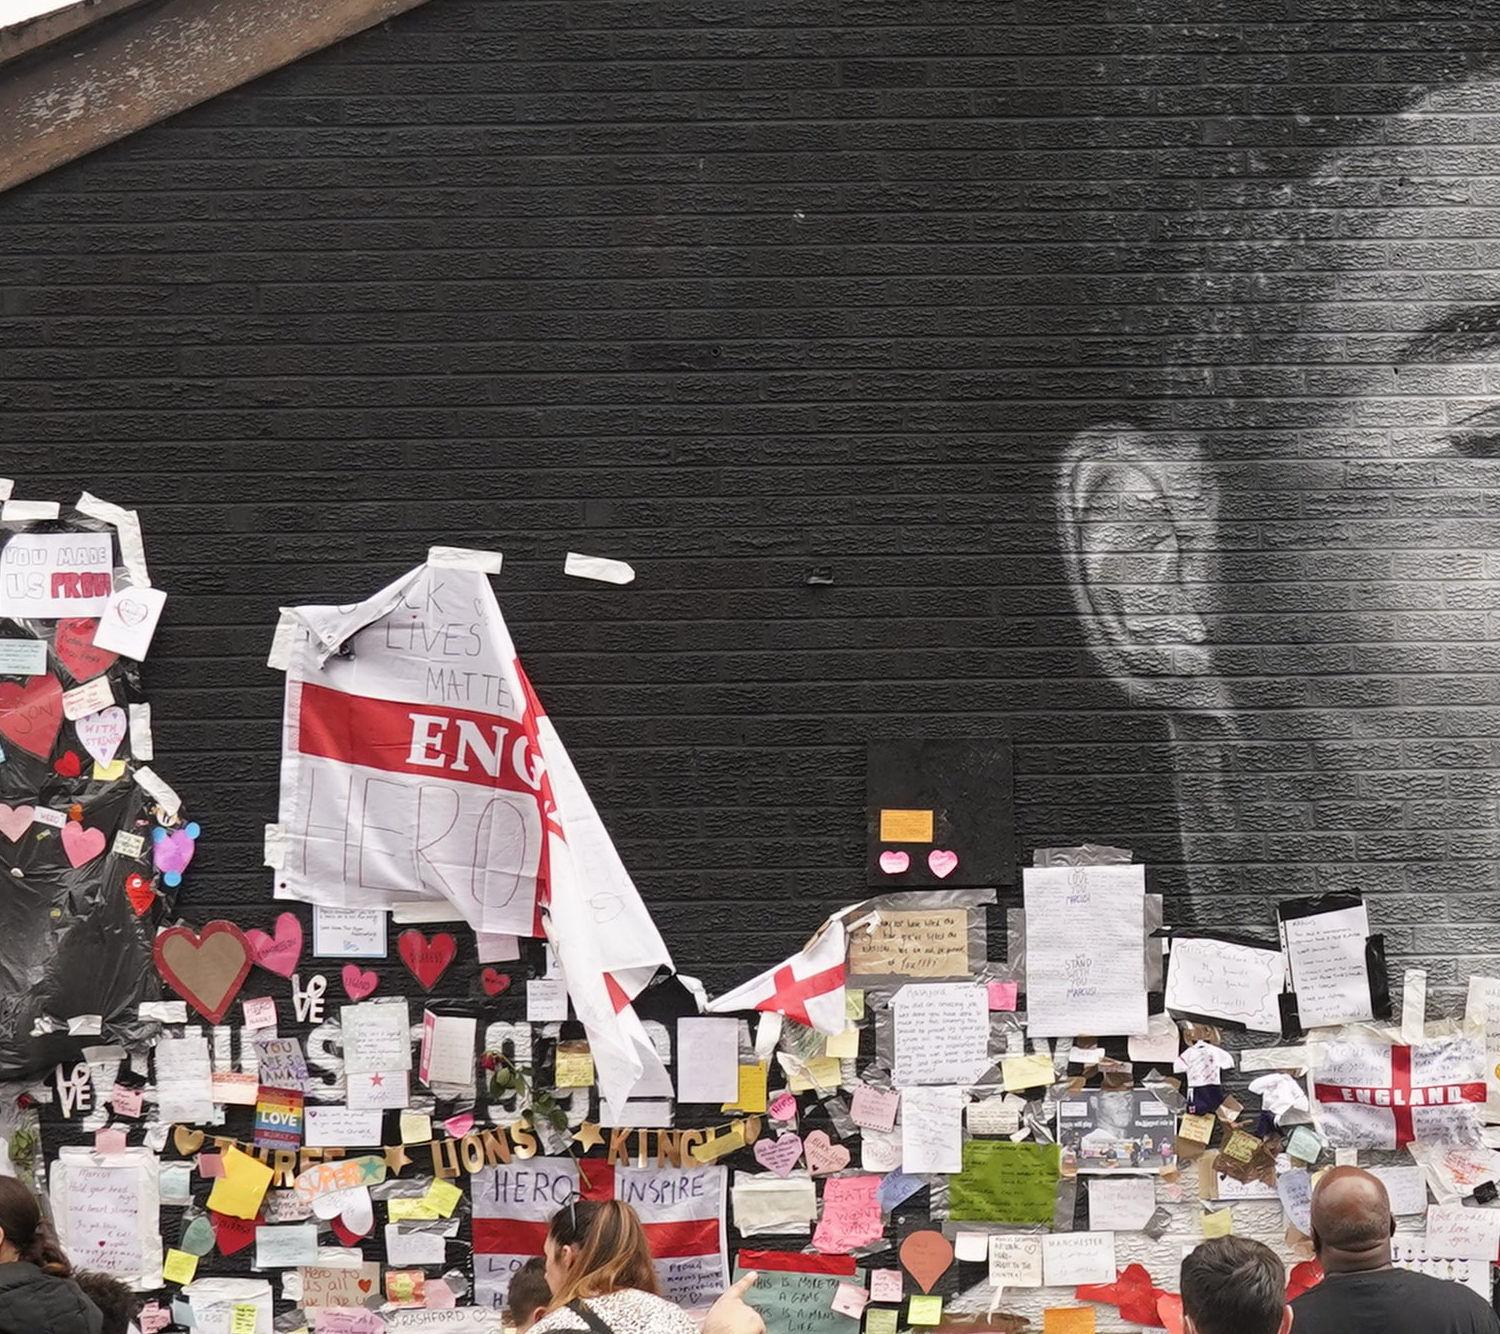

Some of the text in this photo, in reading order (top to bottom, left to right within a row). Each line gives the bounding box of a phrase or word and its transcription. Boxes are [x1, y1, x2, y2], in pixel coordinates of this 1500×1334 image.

[6, 548, 106, 566] YOU MADE
[6, 573, 43, 599] US
[386, 622, 481, 657] LIVES
[304, 768, 527, 908] HERO
[261, 1041, 293, 1054] YOU
[1341, 1085, 1461, 1106] ENGLAND
[261, 1111, 297, 1127] LOVE
[431, 1120, 538, 1178] LIONS
[608, 1126, 718, 1167] KING
[295, 1165, 362, 1203] SUPER
[494, 1171, 705, 1206] HERO INSPIRE
[832, 1188, 876, 1202] HATE
[752, 1278, 772, 1289] HIS
[402, 1310, 465, 1327] RASHFORD
